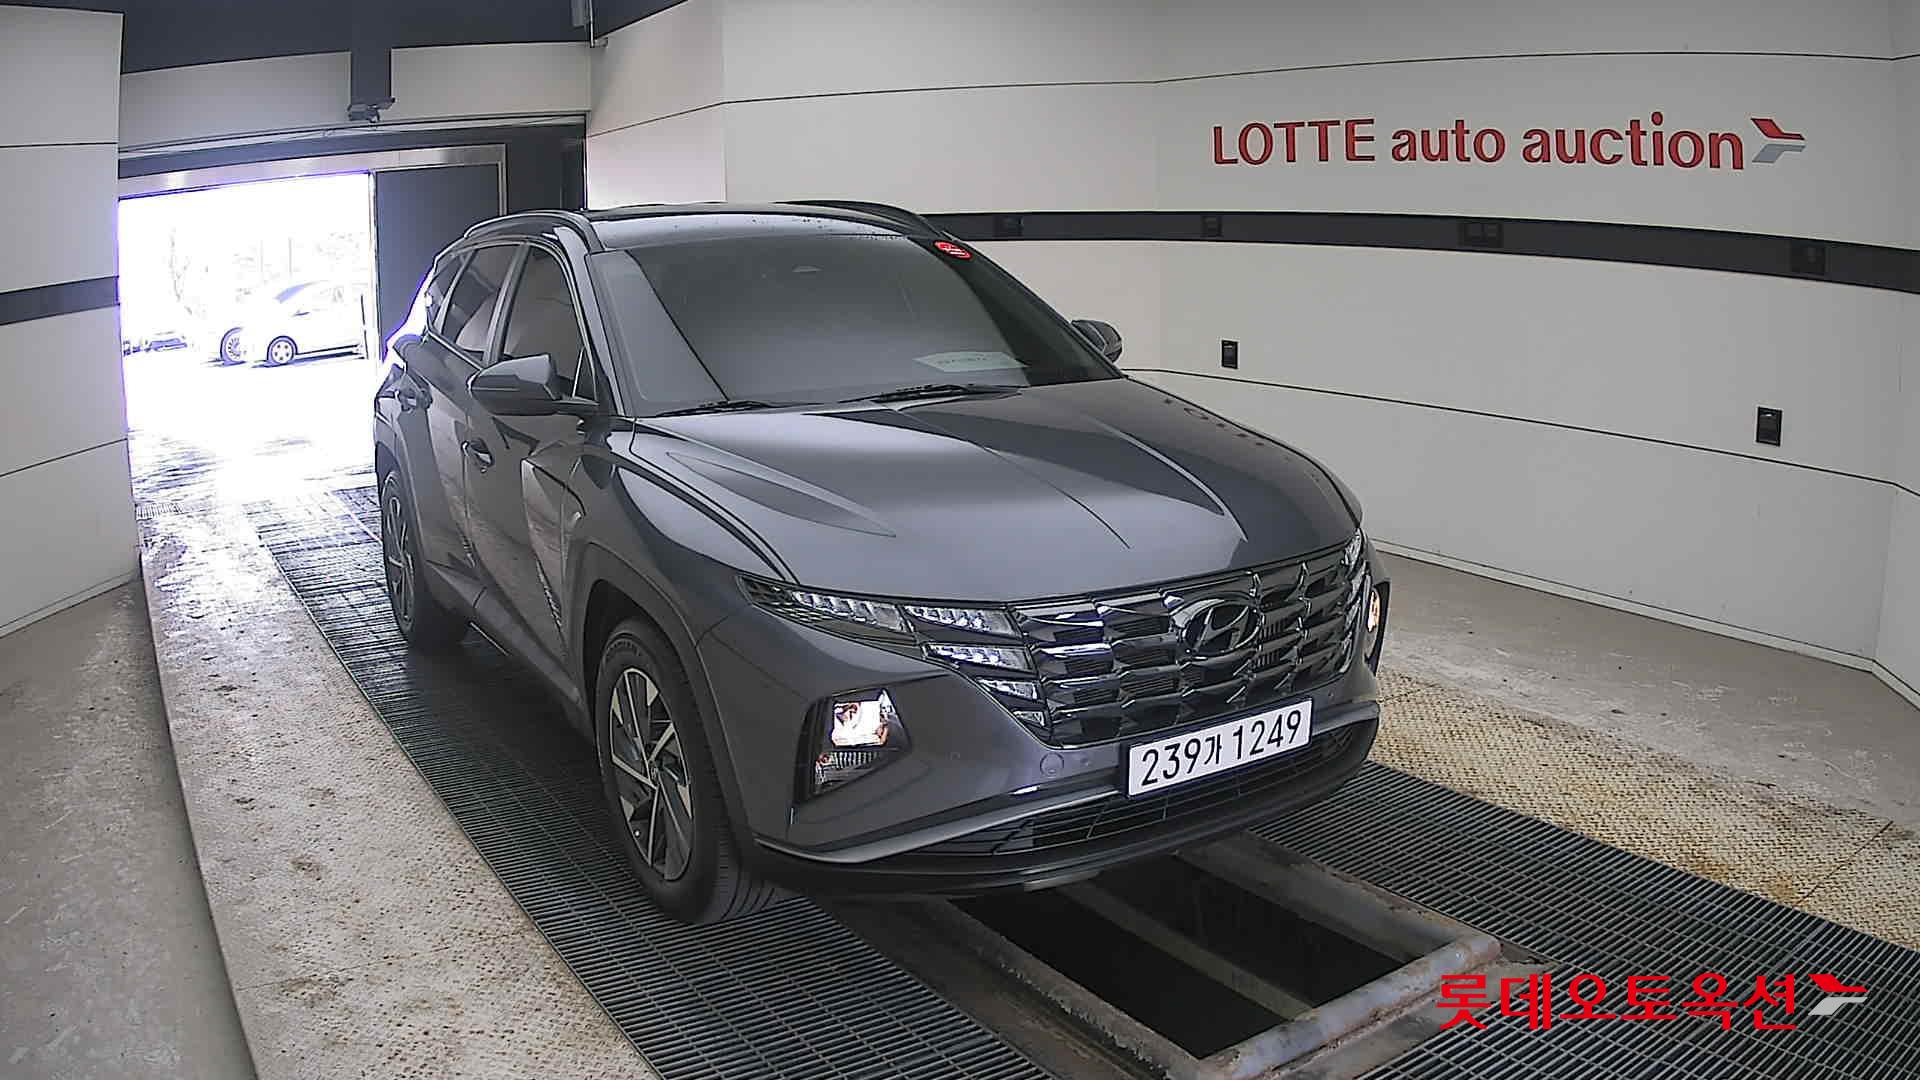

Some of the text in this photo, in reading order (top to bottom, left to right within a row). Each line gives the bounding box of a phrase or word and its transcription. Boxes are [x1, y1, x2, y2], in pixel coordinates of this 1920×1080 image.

[1213, 111, 1744, 170] LOTTE auto auction
[1141, 710, 1301, 786] 239가 1249
